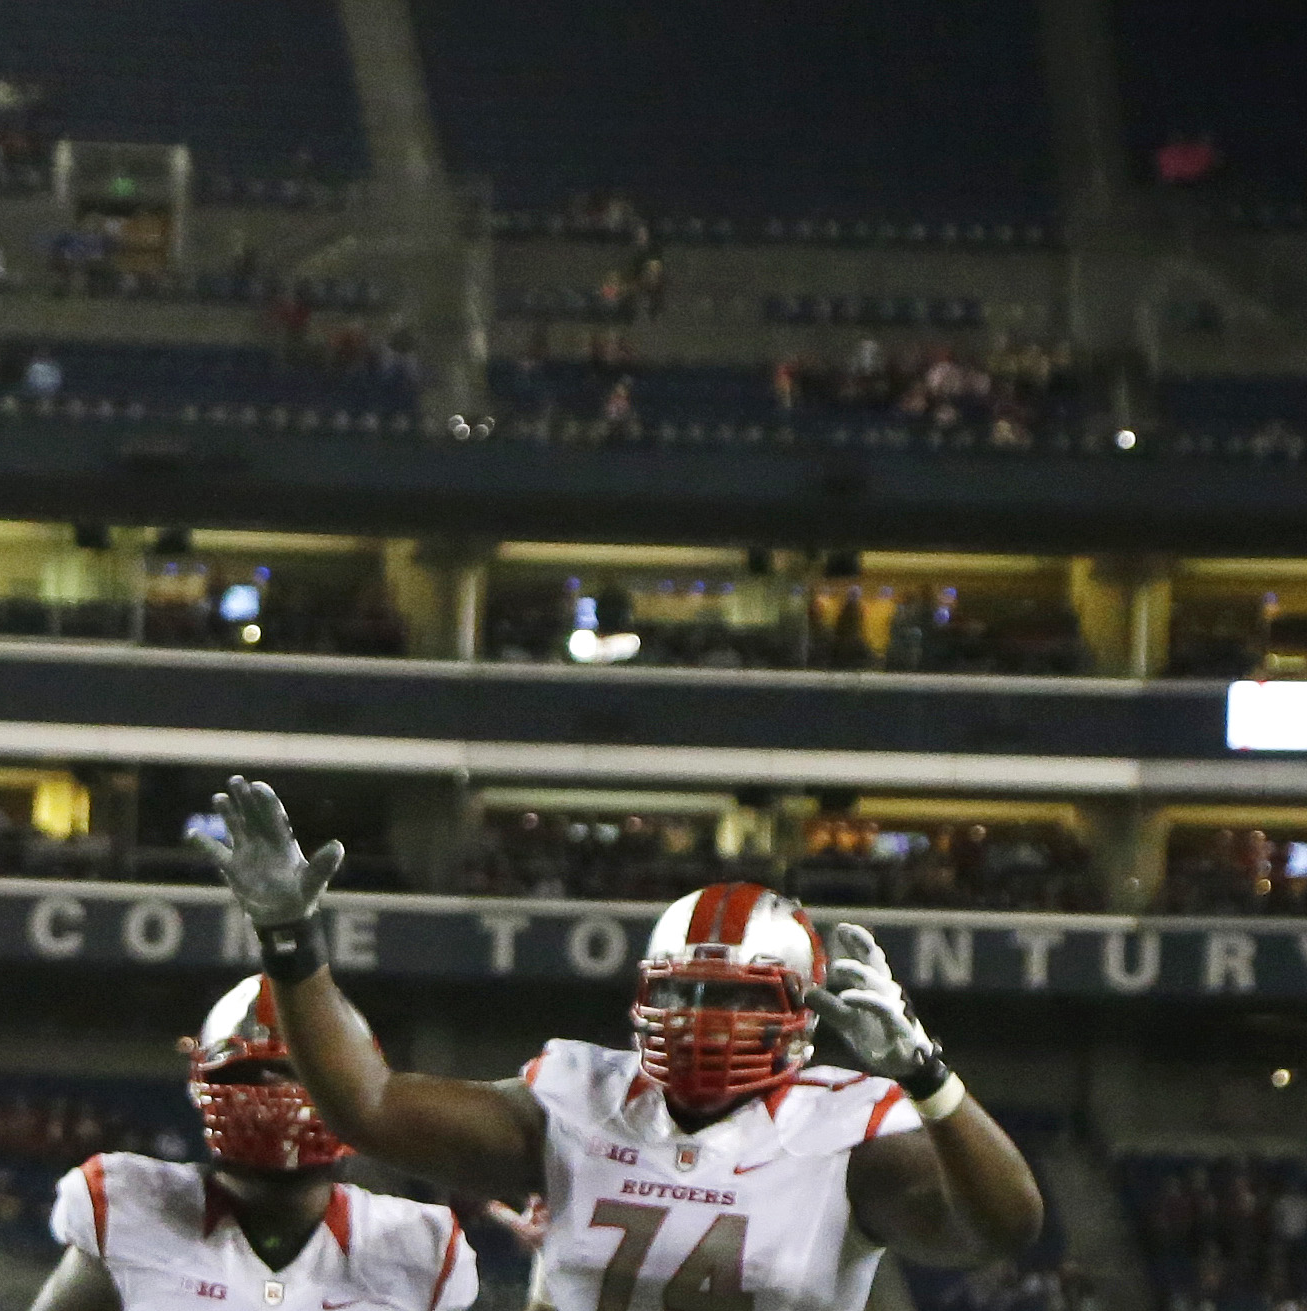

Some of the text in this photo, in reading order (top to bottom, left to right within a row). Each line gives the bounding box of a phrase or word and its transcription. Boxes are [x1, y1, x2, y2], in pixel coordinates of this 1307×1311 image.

[478, 914, 629, 977] TO
[913, 926, 1307, 993] NTUR
[620, 1179, 737, 1206] RUTGERS
